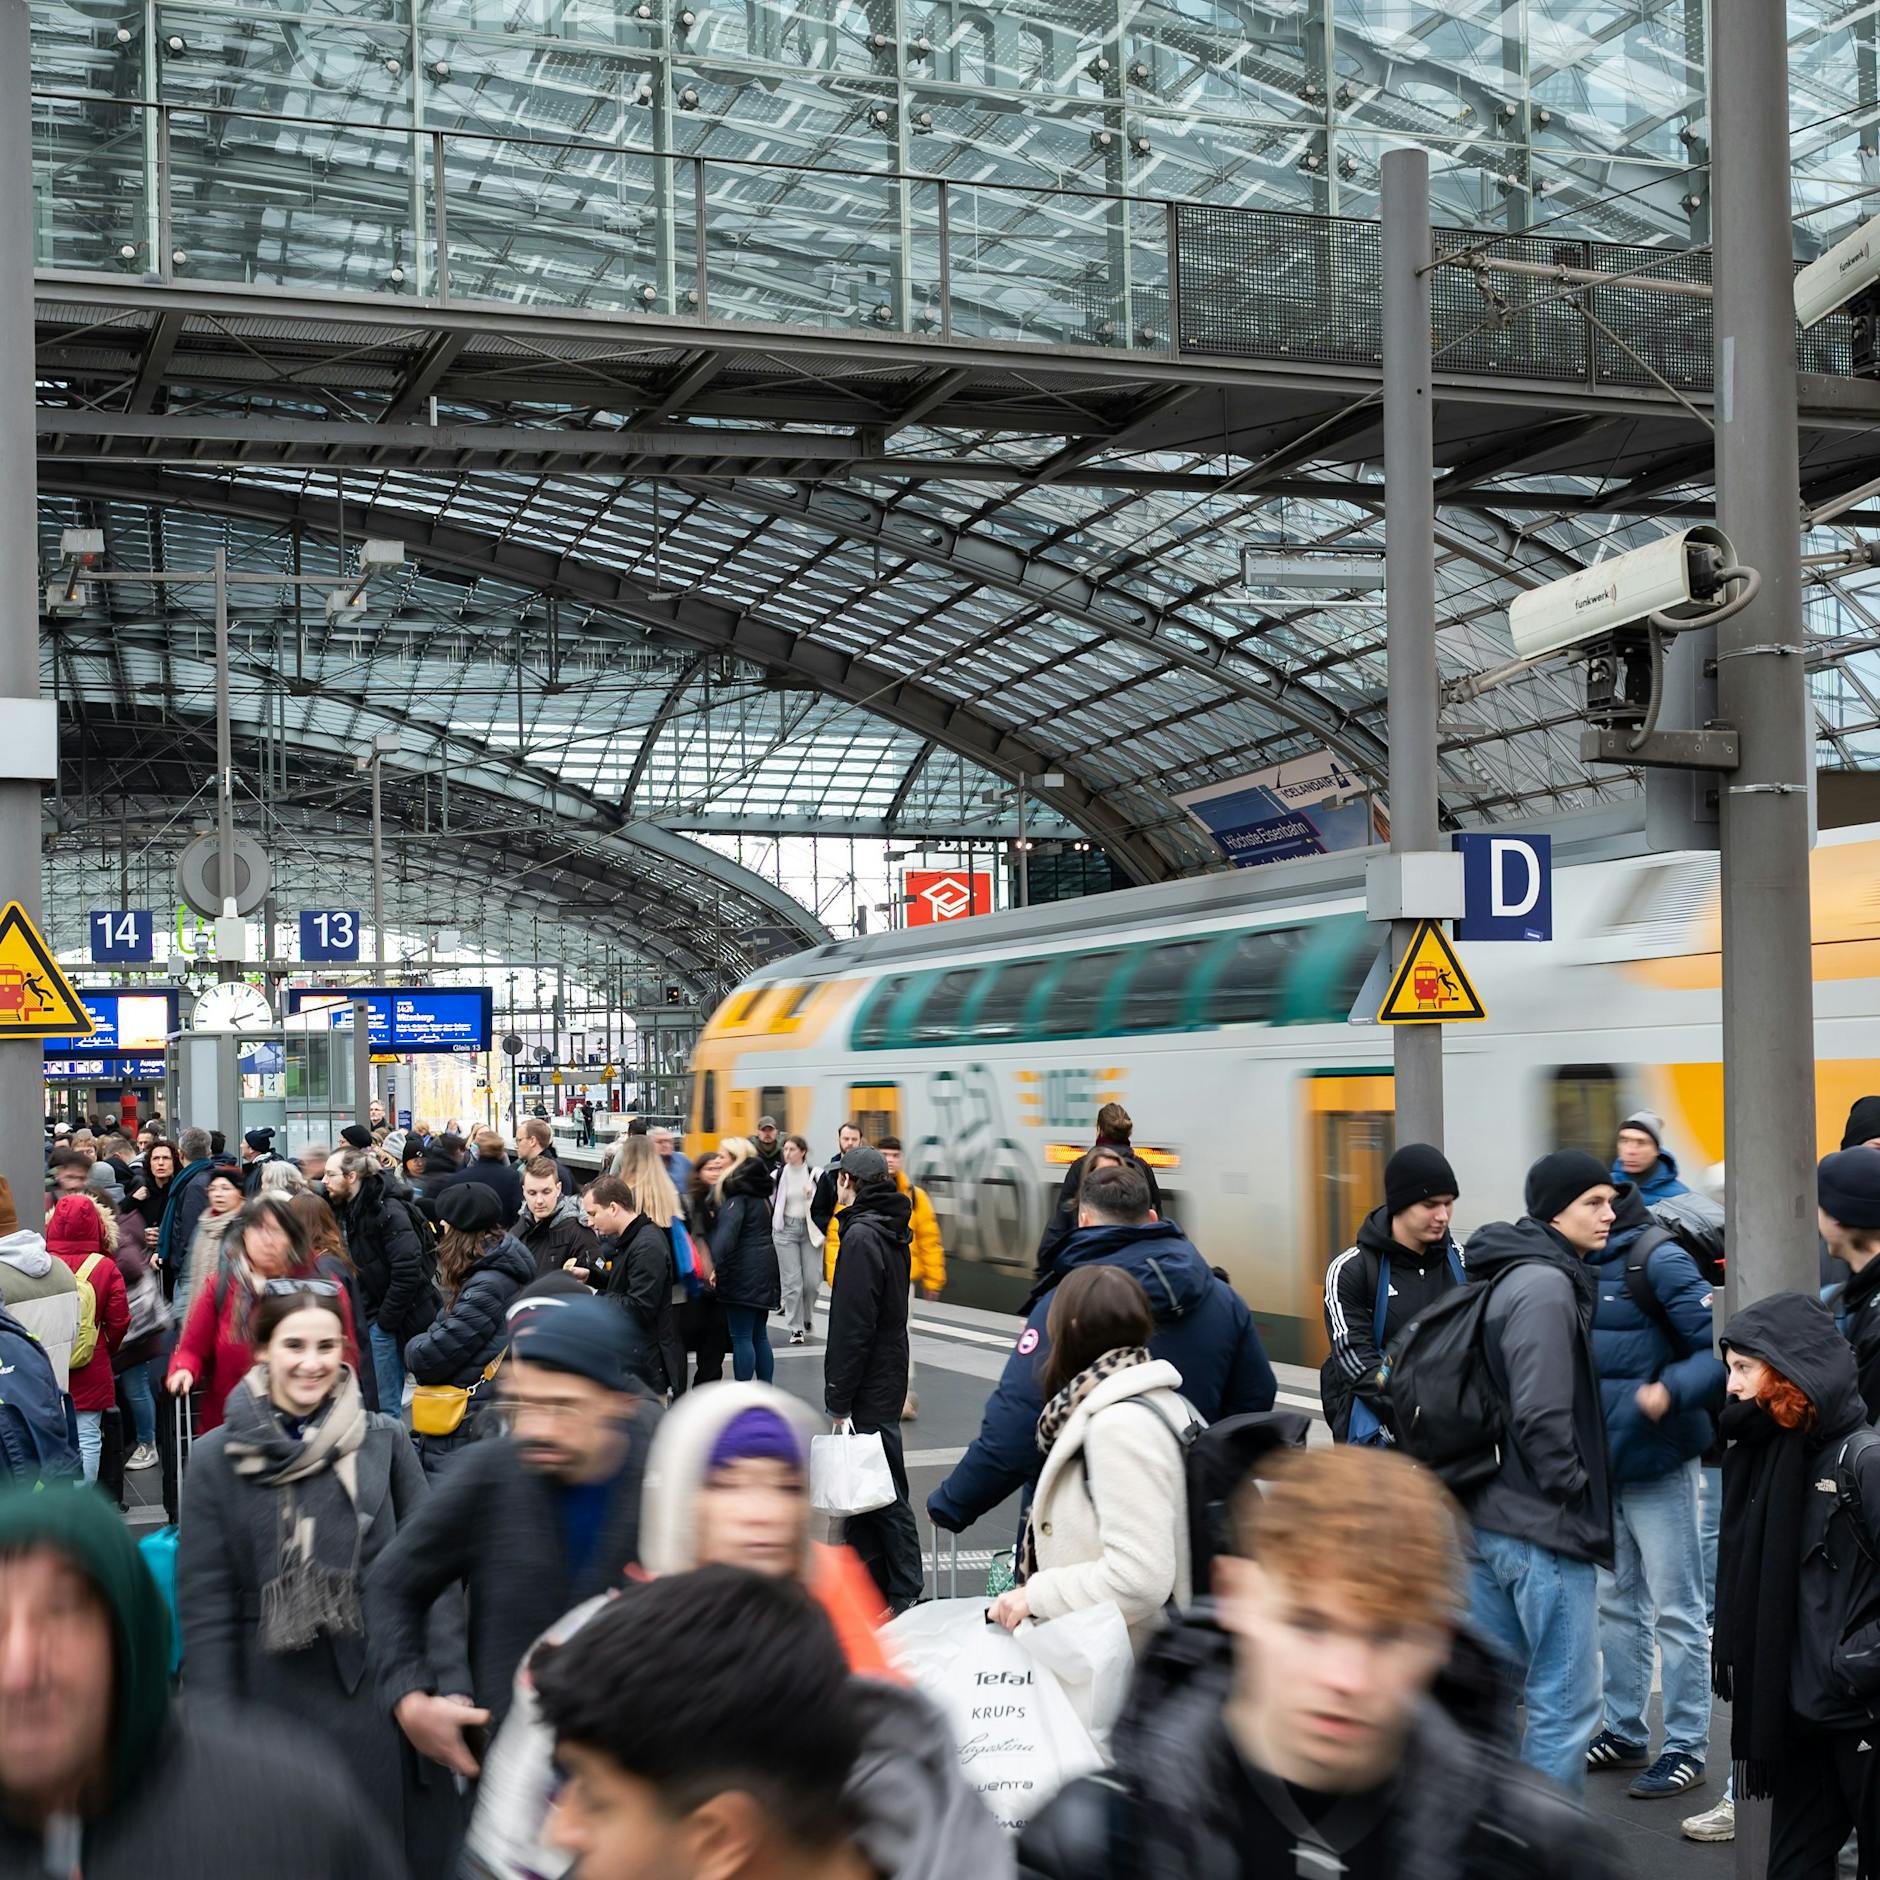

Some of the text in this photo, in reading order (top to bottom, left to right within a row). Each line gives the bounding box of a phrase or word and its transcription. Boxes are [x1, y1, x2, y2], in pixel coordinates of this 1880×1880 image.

[1575, 589, 1610, 610] funkwerk
[1280, 777, 1336, 799] ICELANDAIR
[1221, 820, 1310, 850] Höchste Eisenbahn
[1490, 839, 1541, 917] D
[97, 912, 140, 949] 14
[313, 912, 353, 949] 13
[541, 1054, 547, 1064] F
[268, 1081, 276, 1092] 4
[528, 1074, 537, 1083] 12
[974, 1670, 1035, 1687] Tefal
[971, 1705, 1026, 1720] KRUPS
